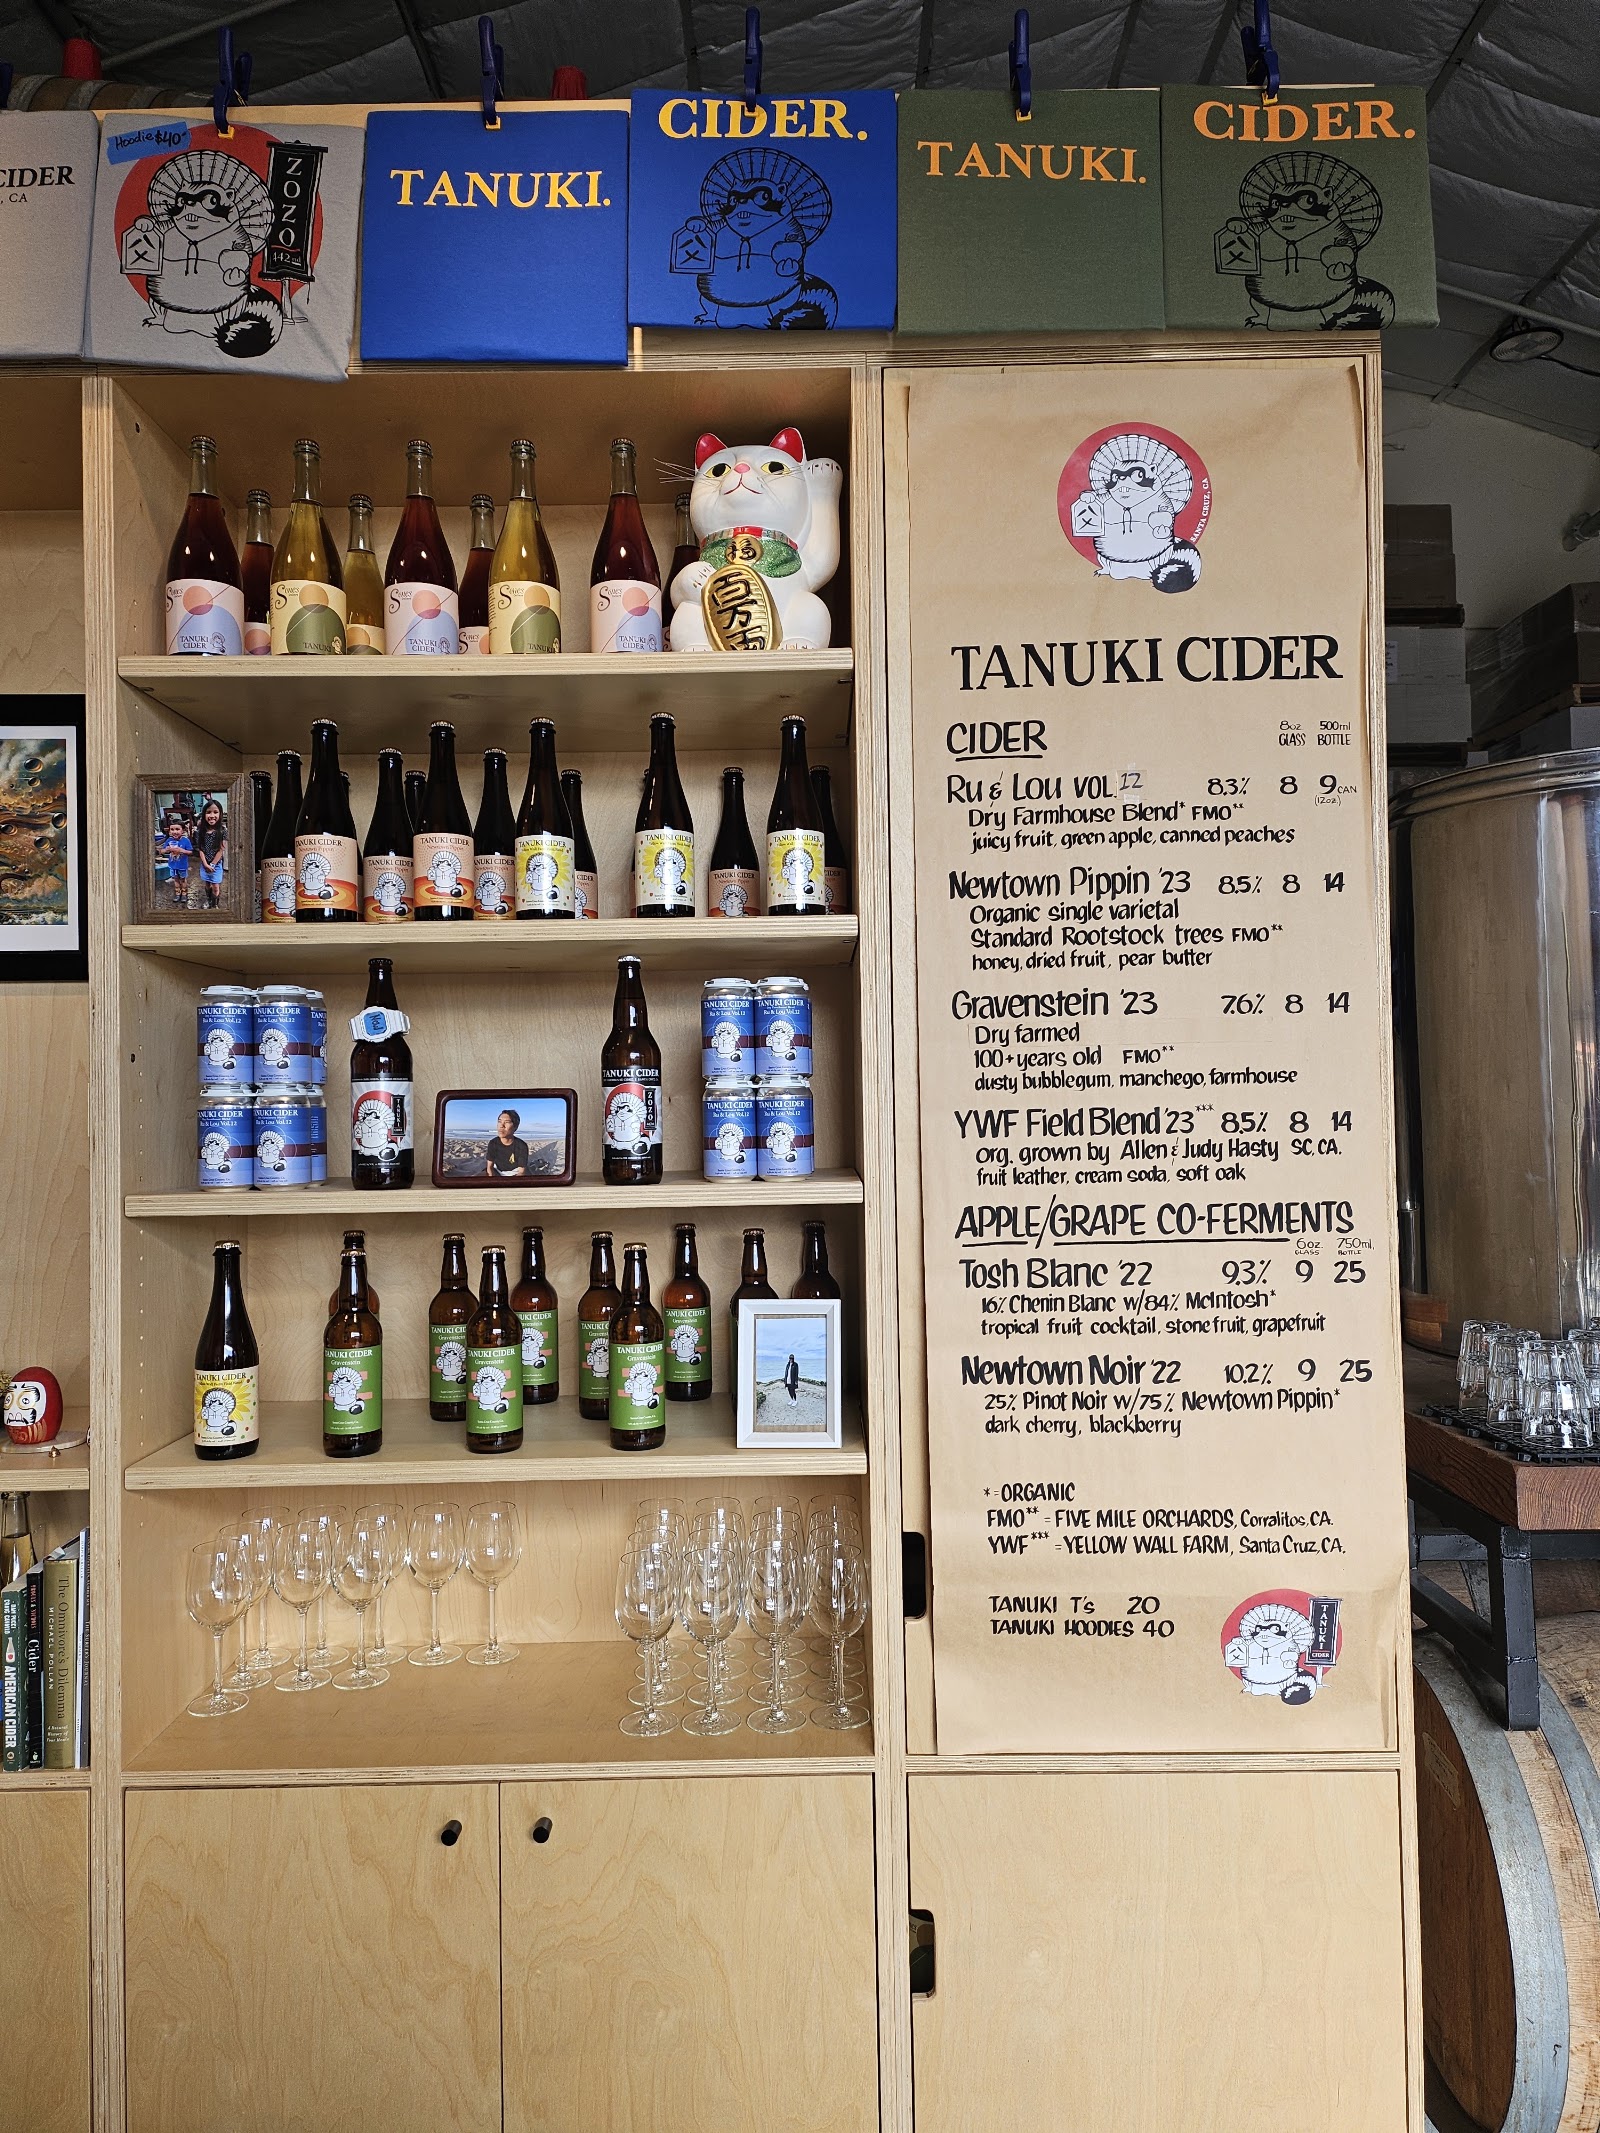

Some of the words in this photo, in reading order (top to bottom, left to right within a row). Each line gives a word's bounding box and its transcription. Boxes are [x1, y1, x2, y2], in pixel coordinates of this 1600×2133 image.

[657, 98, 868, 140] CIDER.
[1193, 99, 1416, 143] CIDER.
[114, 131, 154, 150] Hoodie
[916, 140, 1147, 184] TANUKI.
[390, 169, 611, 209] TANUKI.
[1190, 518, 1206, 542] SANTA
[412, 645, 435, 653] CIDER
[619, 636, 646, 644] TANUKI
[623, 642, 644, 650] CIDER
[951, 638, 1163, 690] TANUKI
[1177, 635, 1343, 682] CIDER
[947, 720, 1047, 754] CIDER
[1279, 733, 1306, 746] GLASS
[1317, 734, 1351, 746] BOTTLE
[947, 775, 982, 803] Ru
[1119, 772, 1144, 790] 12
[1280, 776, 1298, 794] 8
[1320, 775, 1337, 794] 9
[1337, 786, 1357, 794] CAN
[450, 838, 469, 846] CIDER
[675, 835, 692, 843] CIDER
[970, 831, 1010, 854] juicy
[1014, 829, 1057, 848] fruit,
[1061, 832, 1105, 849] green
[1108, 826, 1156, 849] apple,
[1160, 825, 1220, 843] canned
[1224, 825, 1295, 846] peaches
[949, 871, 1060, 900] Newtown
[1070, 865, 1149, 903] Pippin
[1282, 874, 1300, 893] 8
[1324, 872, 1345, 892] 14
[970, 903, 1041, 926] Organic
[1047, 900, 1103, 924] single
[1109, 898, 1179, 920] varietal
[973, 954, 1022, 973] honey,
[1026, 951, 1065, 969] dried
[1070, 949, 1111, 969] fruit,
[1119, 953, 1155, 971] pear
[1163, 948, 1213, 966] butter
[952, 988, 1108, 1020] Gravenstein
[1285, 994, 1303, 1014] 8
[1326, 992, 1350, 1013] 14
[975, 1026, 1009, 1047] Dry
[1014, 1022, 1079, 1043] farmed
[603, 1069, 634, 1077] TANUKI
[636, 1069, 659, 1077] CIDER
[975, 1072, 1017, 1094] dusty
[1120, 1069, 1206, 1089] manchego,
[1208, 1067, 1298, 1085] farmhouse
[954, 1110, 1019, 1139] YWF
[1027, 1108, 1084, 1137] Field
[1089, 1107, 1160, 1136] Blend
[1289, 1111, 1309, 1133] 8
[1331, 1111, 1352, 1132] 14
[1157, 1201, 1354, 1235] CO-FERMENTS
[959, 1258, 1019, 1289] Tosh
[1027, 1258, 1108, 1288] Blanc
[1295, 1260, 1313, 1283] 9
[1334, 1260, 1366, 1283] 25
[349, 1349, 372, 1357] CIDER
[492, 1348, 515, 1356] CIDER
[617, 1346, 645, 1354] TANUKI
[646, 1344, 663, 1352] CIDER
[196, 1373, 220, 1381] TANUKI
[961, 1355, 1083, 1385] Newtown
[1088, 1354, 1146, 1385] Noir
[1298, 1359, 1316, 1381] 9
[1339, 1358, 1372, 1382] 25
[985, 1415, 1020, 1433] dark
[1026, 1415, 1081, 1438] cherry,
[1089, 1414, 1181, 1438] blackberry
[58, 1576, 70, 1598] The
[988, 1596, 1057, 1613] TANUKI
[1127, 1595, 1160, 1615] 20
[56, 1602, 68, 1664] Omnivore's
[990, 1619, 1054, 1635] TANUKI
[1064, 1619, 1134, 1637] HOODIES
[1142, 1620, 1174, 1638] 40
[1319, 1604, 1329, 1650] TANUKI
[28, 1639, 40, 1673] Cider
[4, 1666, 17, 1717] AMERICAN
[56, 1668, 70, 1719] Dilemma
[4, 1718, 17, 1748] CIDER
